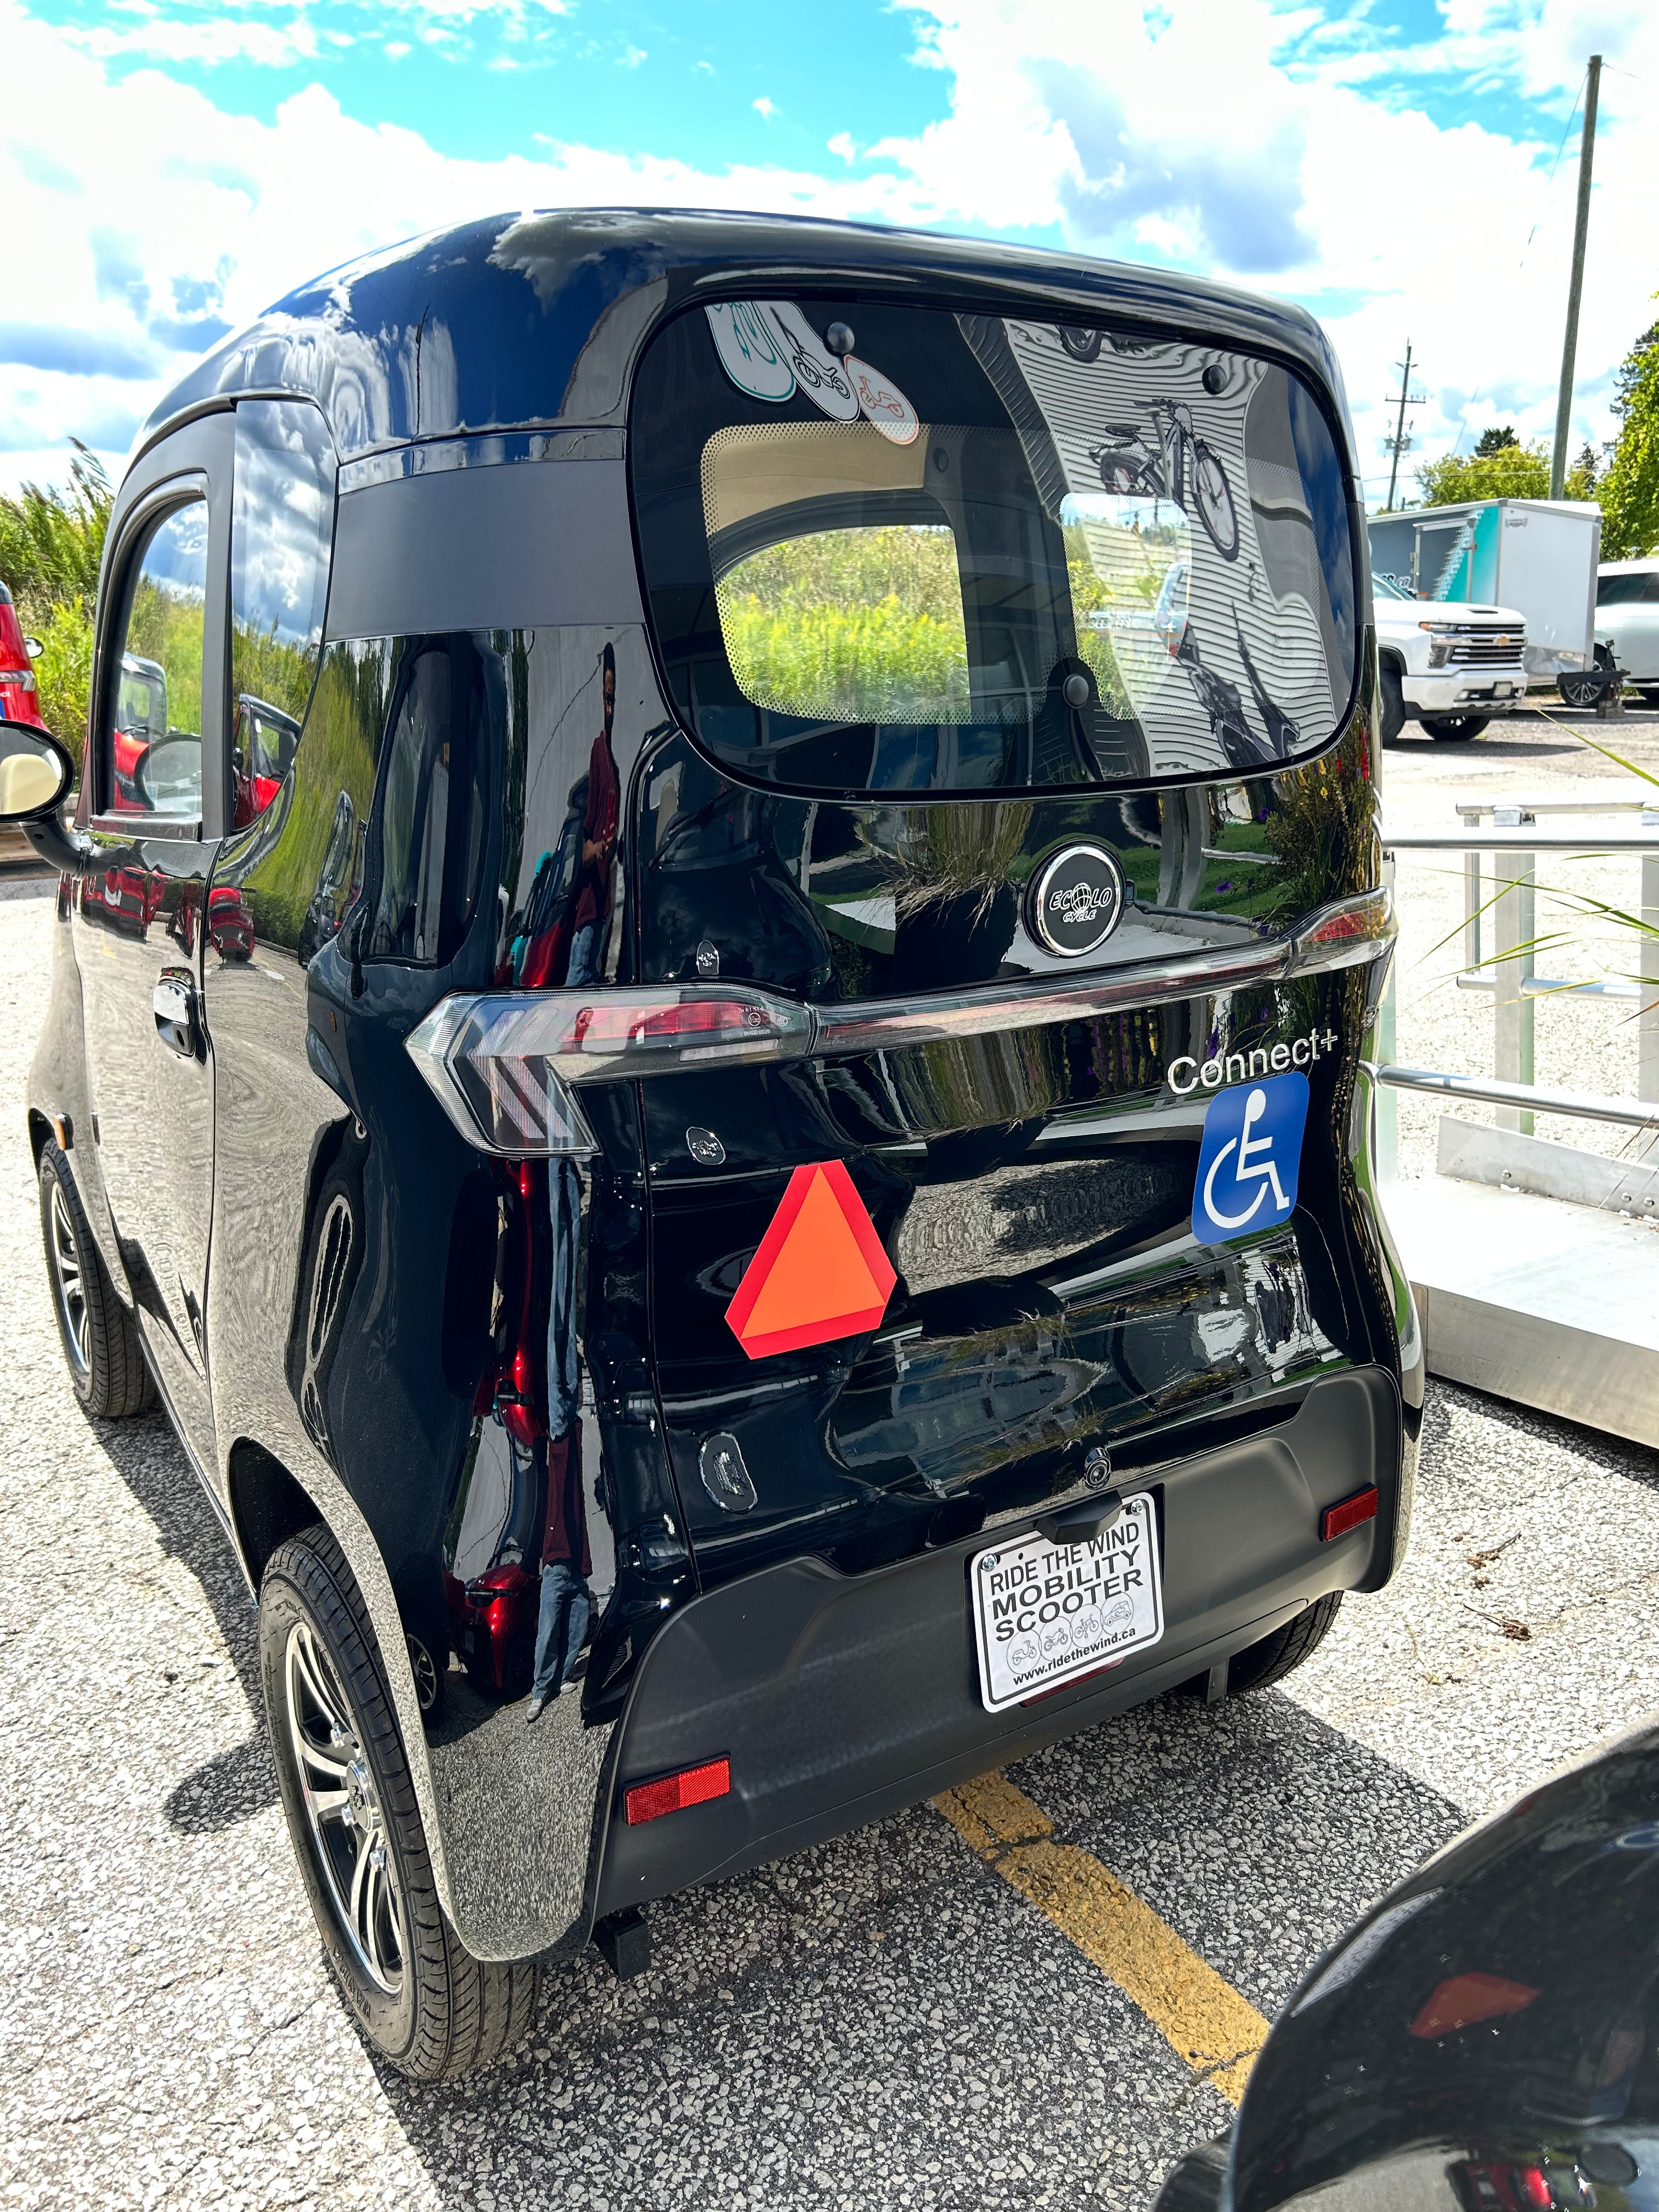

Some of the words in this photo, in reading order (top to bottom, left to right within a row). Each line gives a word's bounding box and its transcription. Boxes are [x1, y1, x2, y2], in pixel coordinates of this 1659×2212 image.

[1062, 909, 1097, 923] CYCLE
[990, 1559, 1039, 1595] RIDE
[1042, 1543, 1083, 1574] THE
[1087, 1522, 1139, 1558] WIND
[992, 1544, 1140, 1620] MOBILITY
[996, 1568, 1144, 1642] SCOOTER
[1013, 1627, 1136, 1685] www.ridethewind.ca
